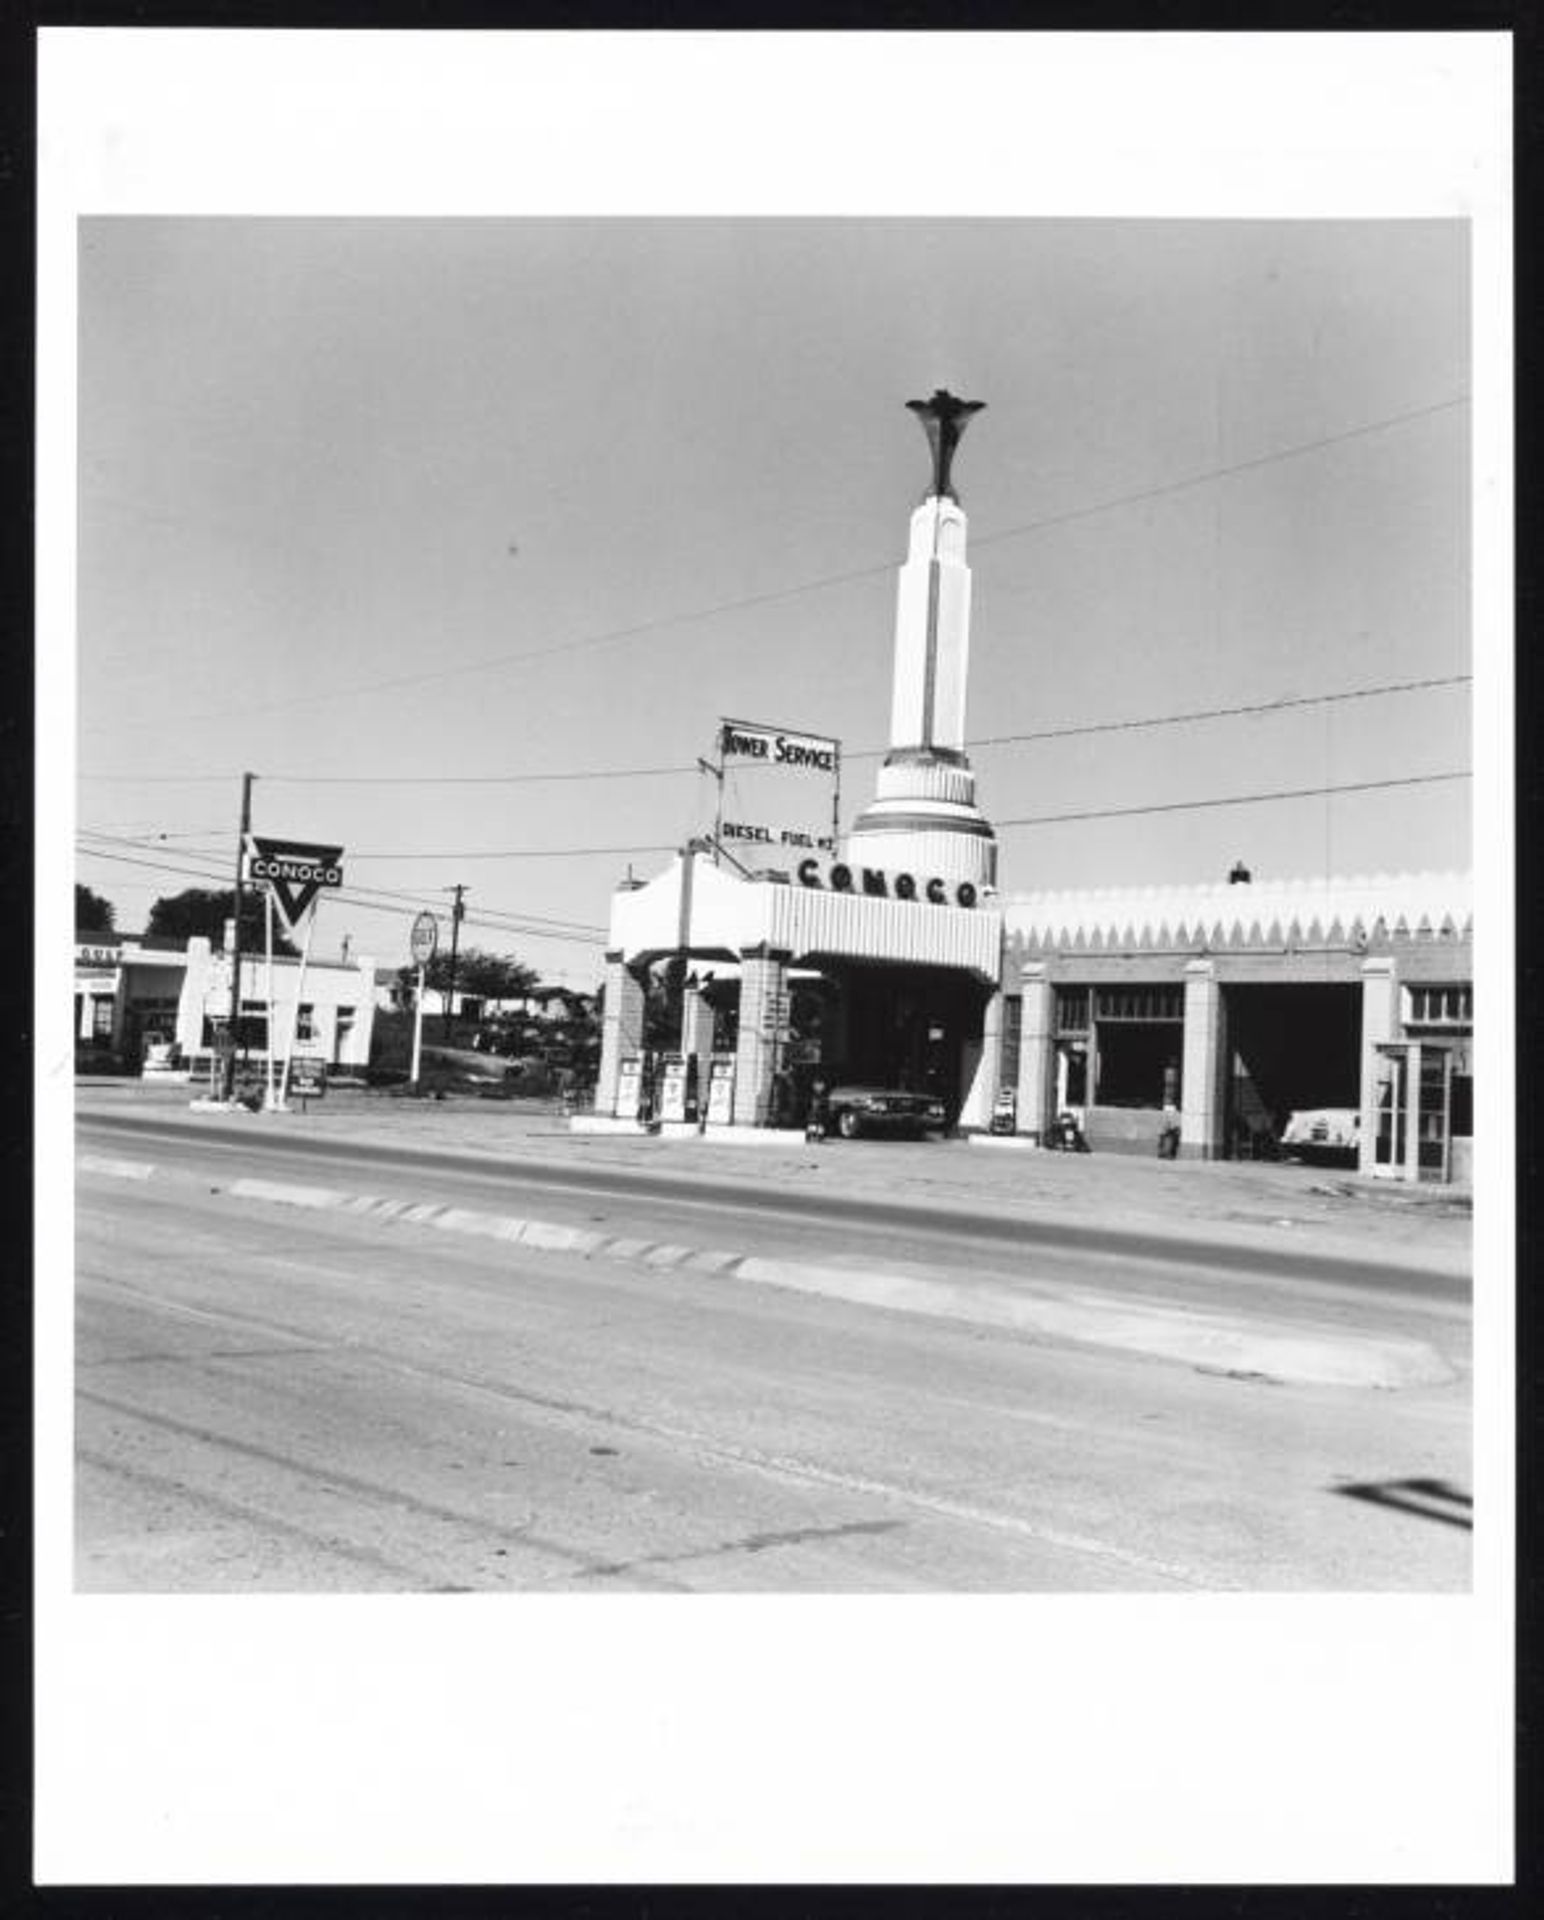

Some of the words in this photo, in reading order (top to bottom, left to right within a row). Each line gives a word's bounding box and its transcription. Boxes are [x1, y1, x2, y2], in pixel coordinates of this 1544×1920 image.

[775, 737, 832, 770] SERVICE
[723, 823, 774, 844] DIESEL
[781, 831, 814, 848] FUEL
[253, 860, 339, 883] CONOCO
[797, 858, 977, 907] CONOCO
